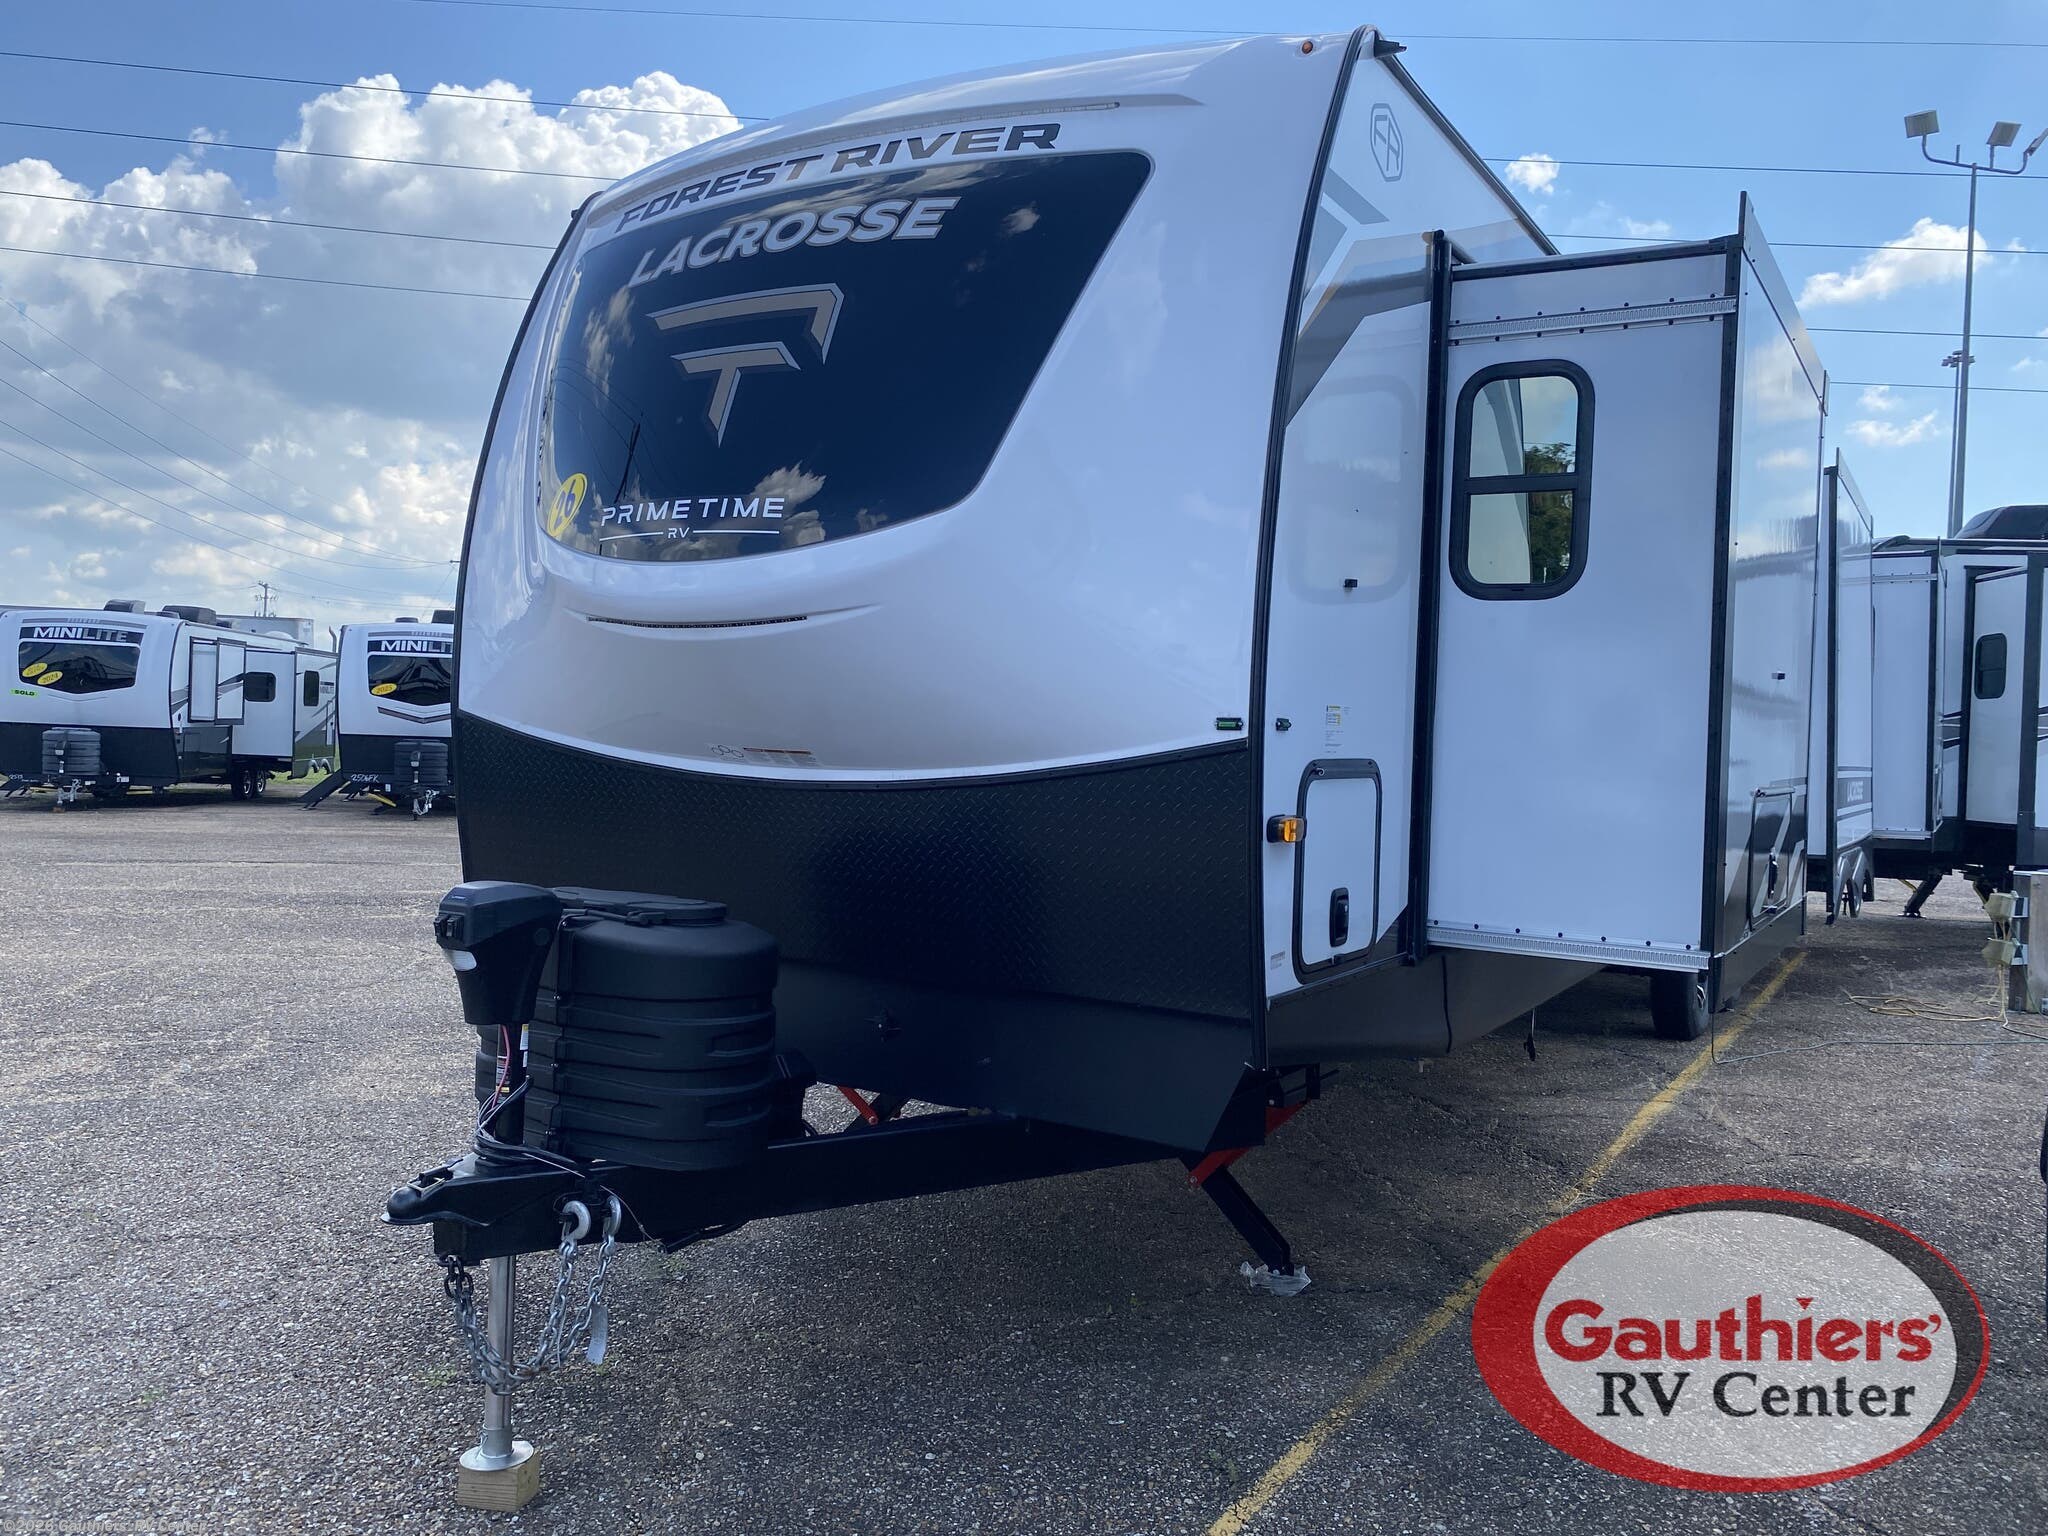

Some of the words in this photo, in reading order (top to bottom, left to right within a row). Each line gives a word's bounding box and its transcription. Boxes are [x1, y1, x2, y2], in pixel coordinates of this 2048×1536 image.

[615, 153, 825, 234] FOREST
[830, 122, 1062, 174] RIVER
[627, 195, 963, 288] LACROSSE
[600, 499, 692, 528] PRIME
[698, 497, 786, 519] TIME
[668, 527, 691, 539] RV
[33, 626, 129, 642] MINILITE
[380, 640, 454, 653] MINILIT
